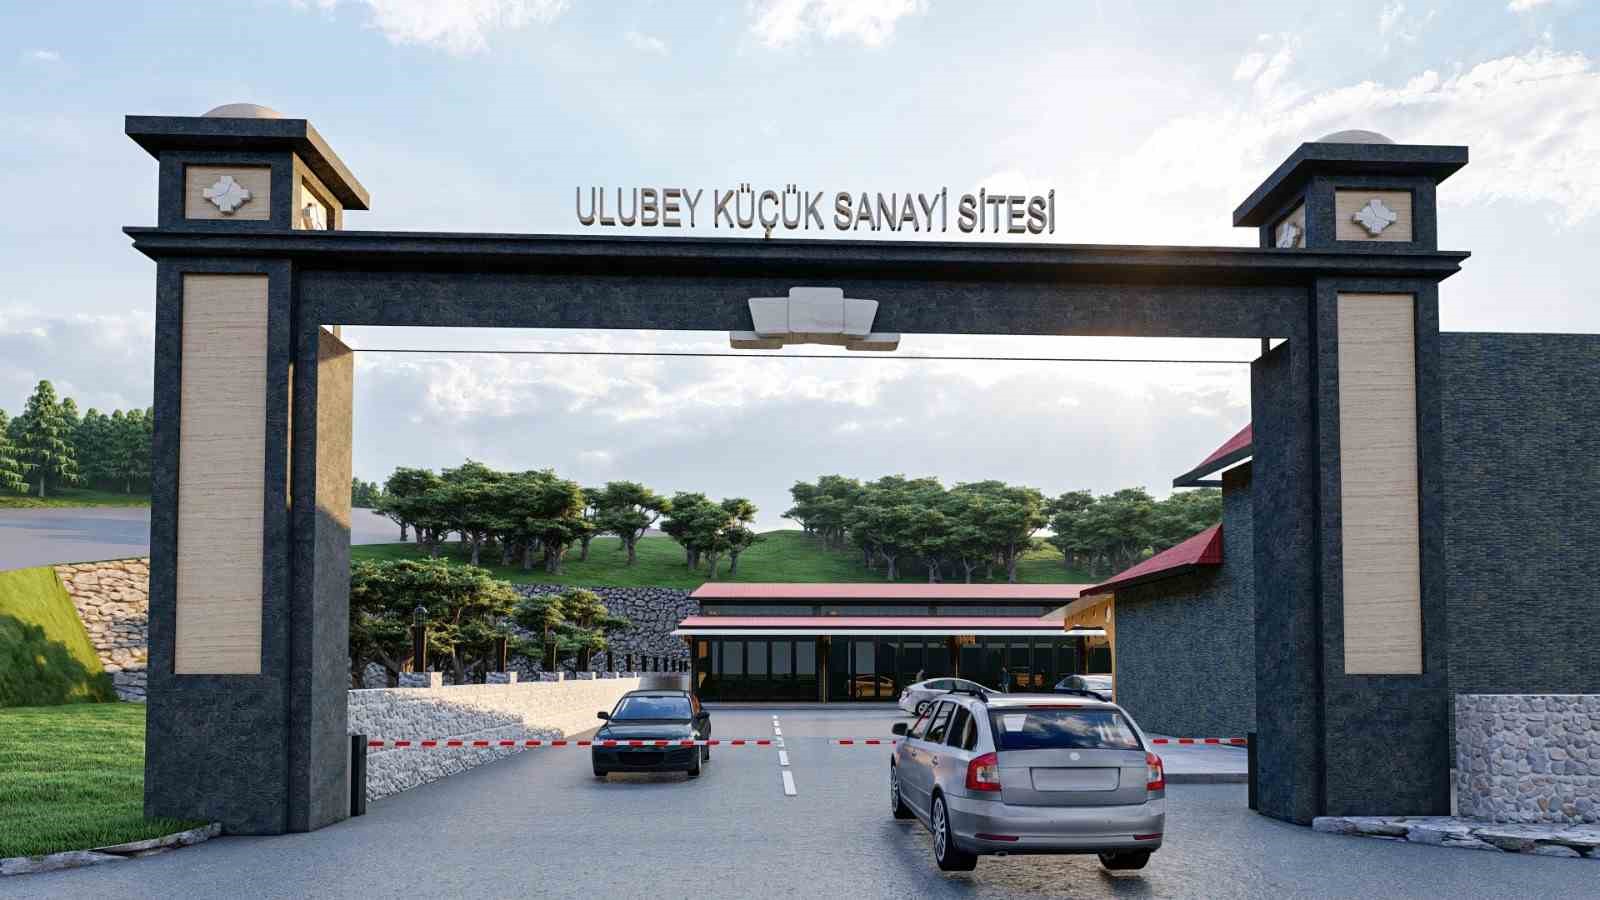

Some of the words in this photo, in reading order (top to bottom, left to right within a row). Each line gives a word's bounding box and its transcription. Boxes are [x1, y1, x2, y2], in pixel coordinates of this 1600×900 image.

[576, 186, 703, 228] ULUBEY
[713, 183, 825, 240] KÜÇÜK
[833, 187, 947, 233] SANAYİ
[957, 187, 1056, 235] SİTESİ
